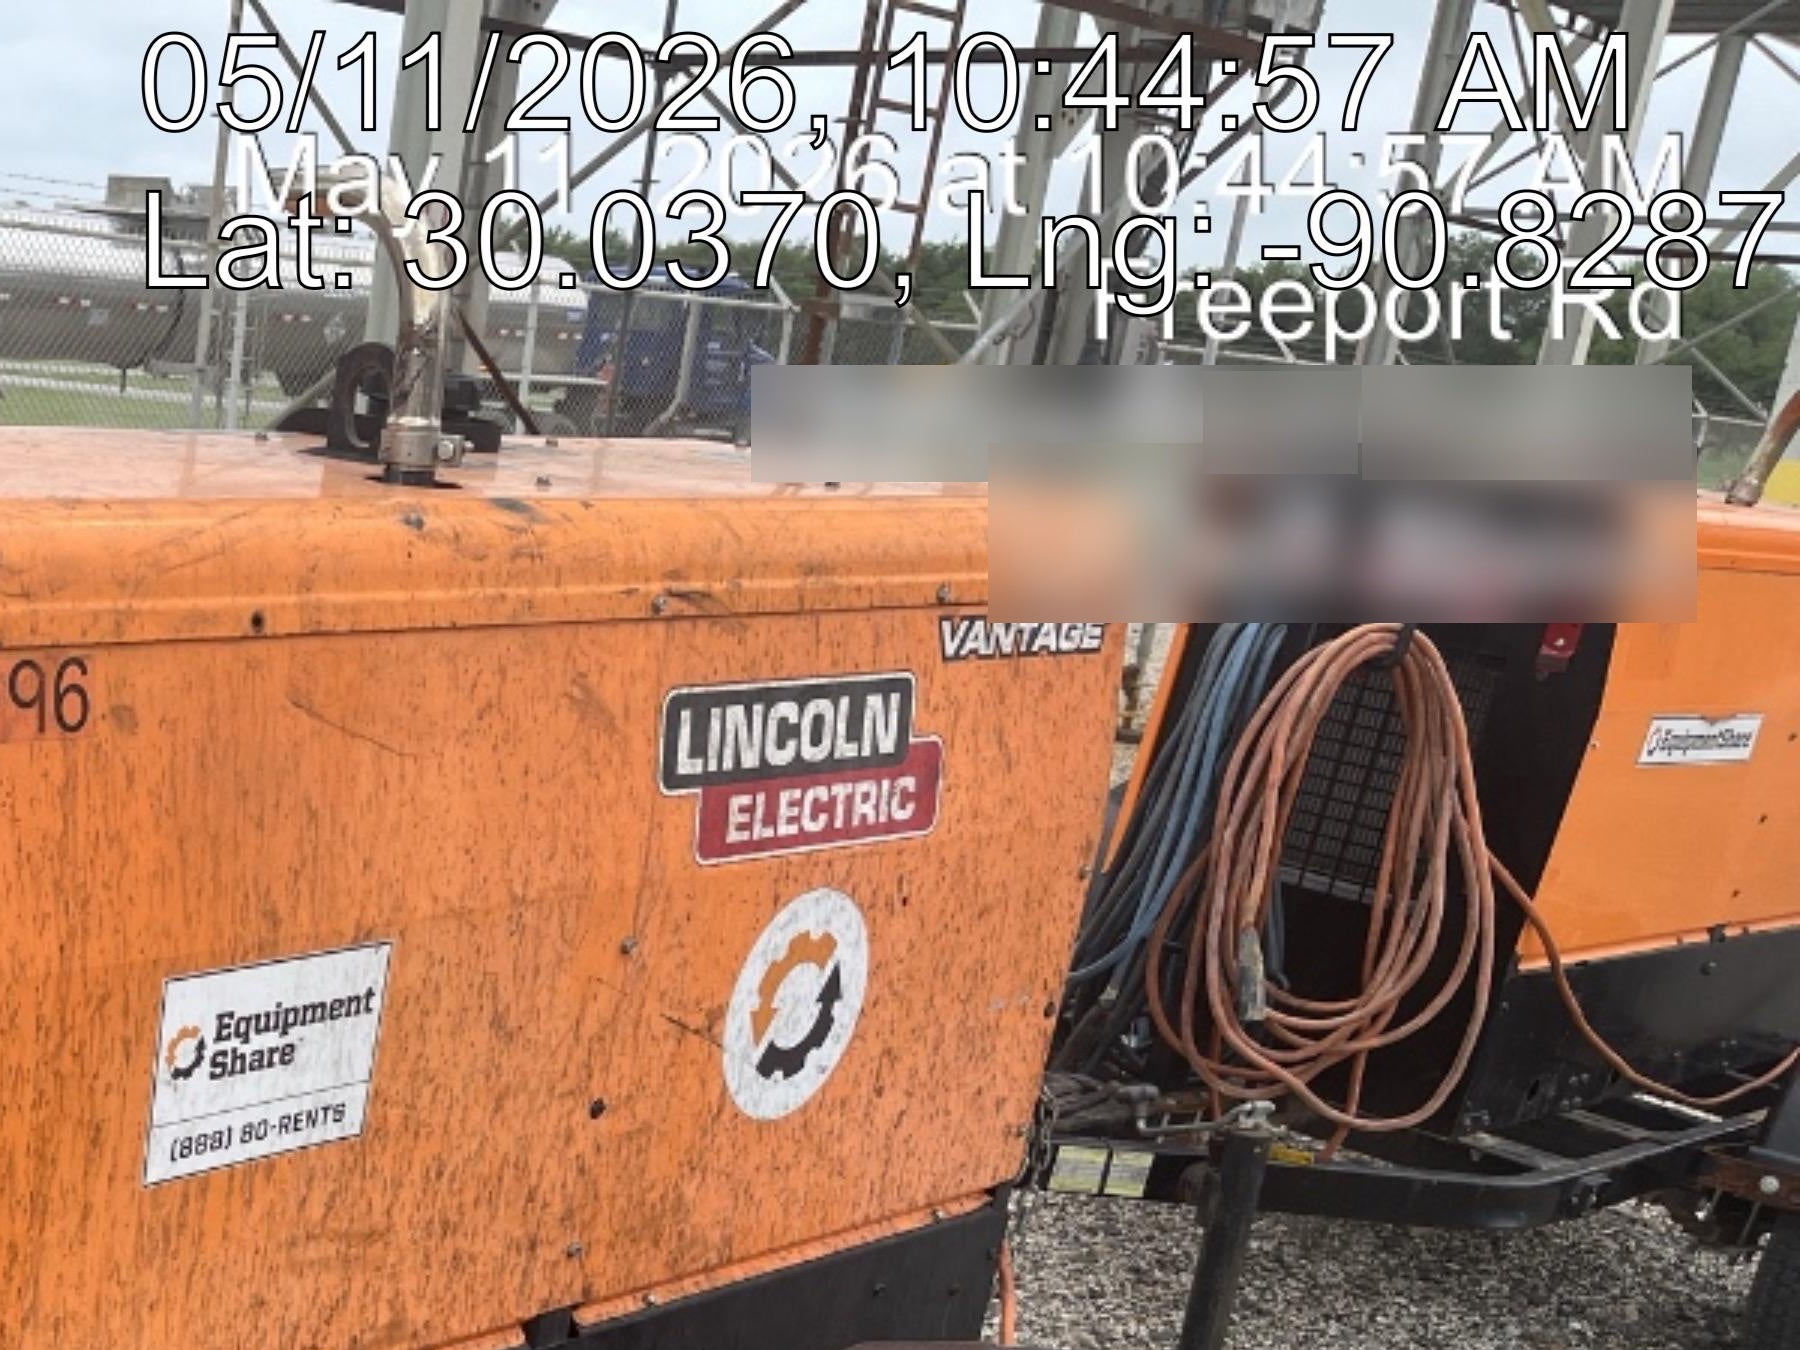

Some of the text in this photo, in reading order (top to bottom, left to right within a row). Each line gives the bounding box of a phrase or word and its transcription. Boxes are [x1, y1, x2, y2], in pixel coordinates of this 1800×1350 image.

[940, 620, 1105, 658] VANTAGE
[676, 691, 901, 776] LINCOLN
[725, 775, 917, 845] ELECTRIC
[213, 986, 376, 1044] Equipment
[208, 1041, 297, 1081] Share
[170, 1102, 347, 1163] (888) 80-RENTS
